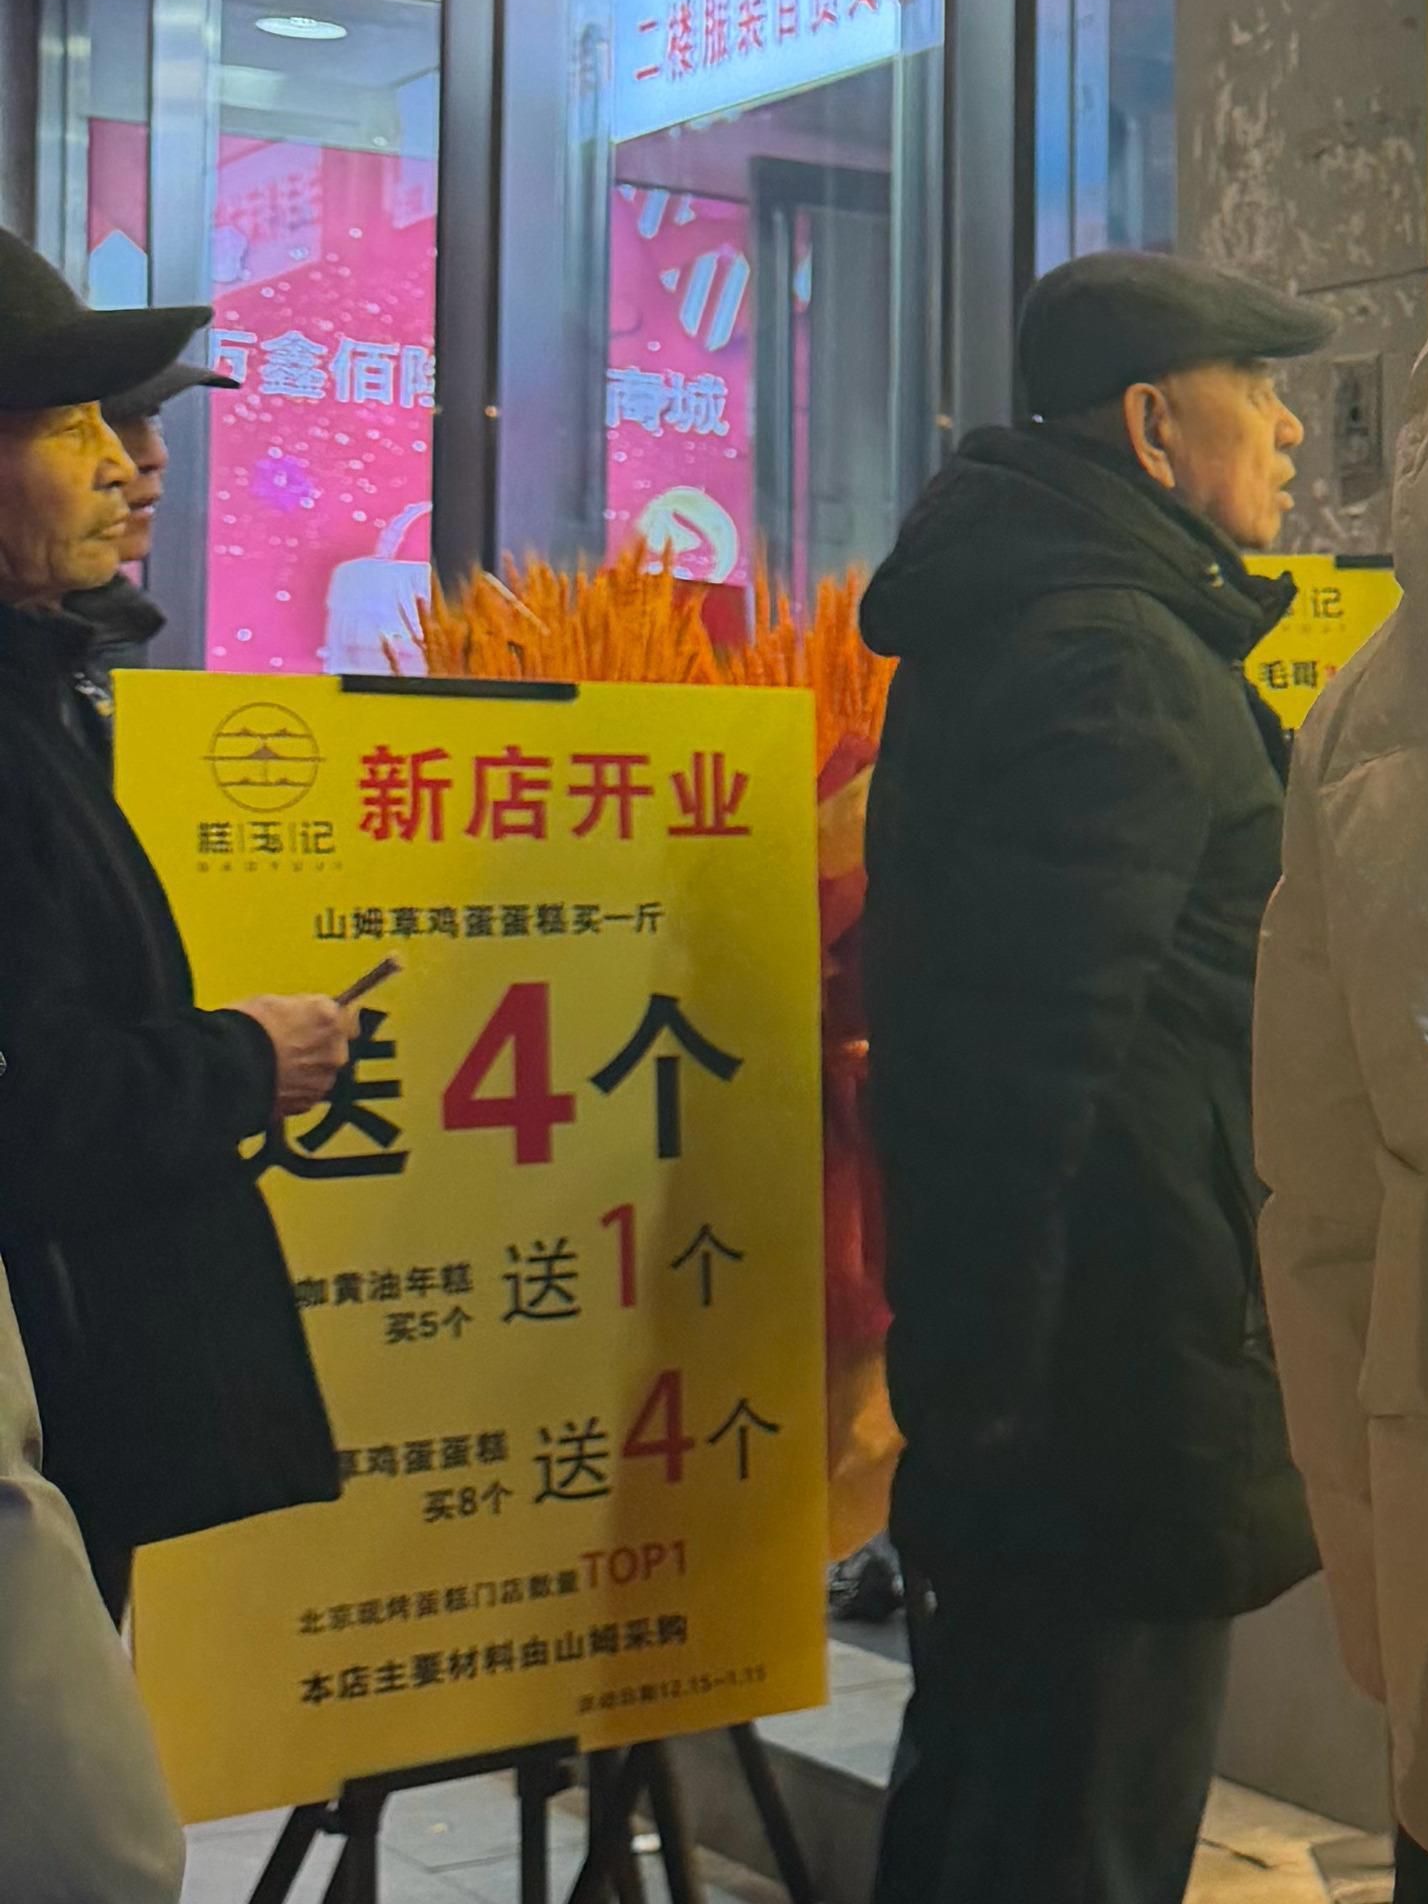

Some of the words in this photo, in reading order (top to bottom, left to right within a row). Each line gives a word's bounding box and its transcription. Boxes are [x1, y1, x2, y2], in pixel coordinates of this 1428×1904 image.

[358, 743, 752, 843] 新店开业
[313, 900, 665, 942] 山姆草鸡蛋蛋糕买一斤
[383, 1304, 474, 1345] 买5个
[421, 1481, 515, 1523] 买8个
[299, 1613, 688, 1707] 本店主要材料由山姆采购
